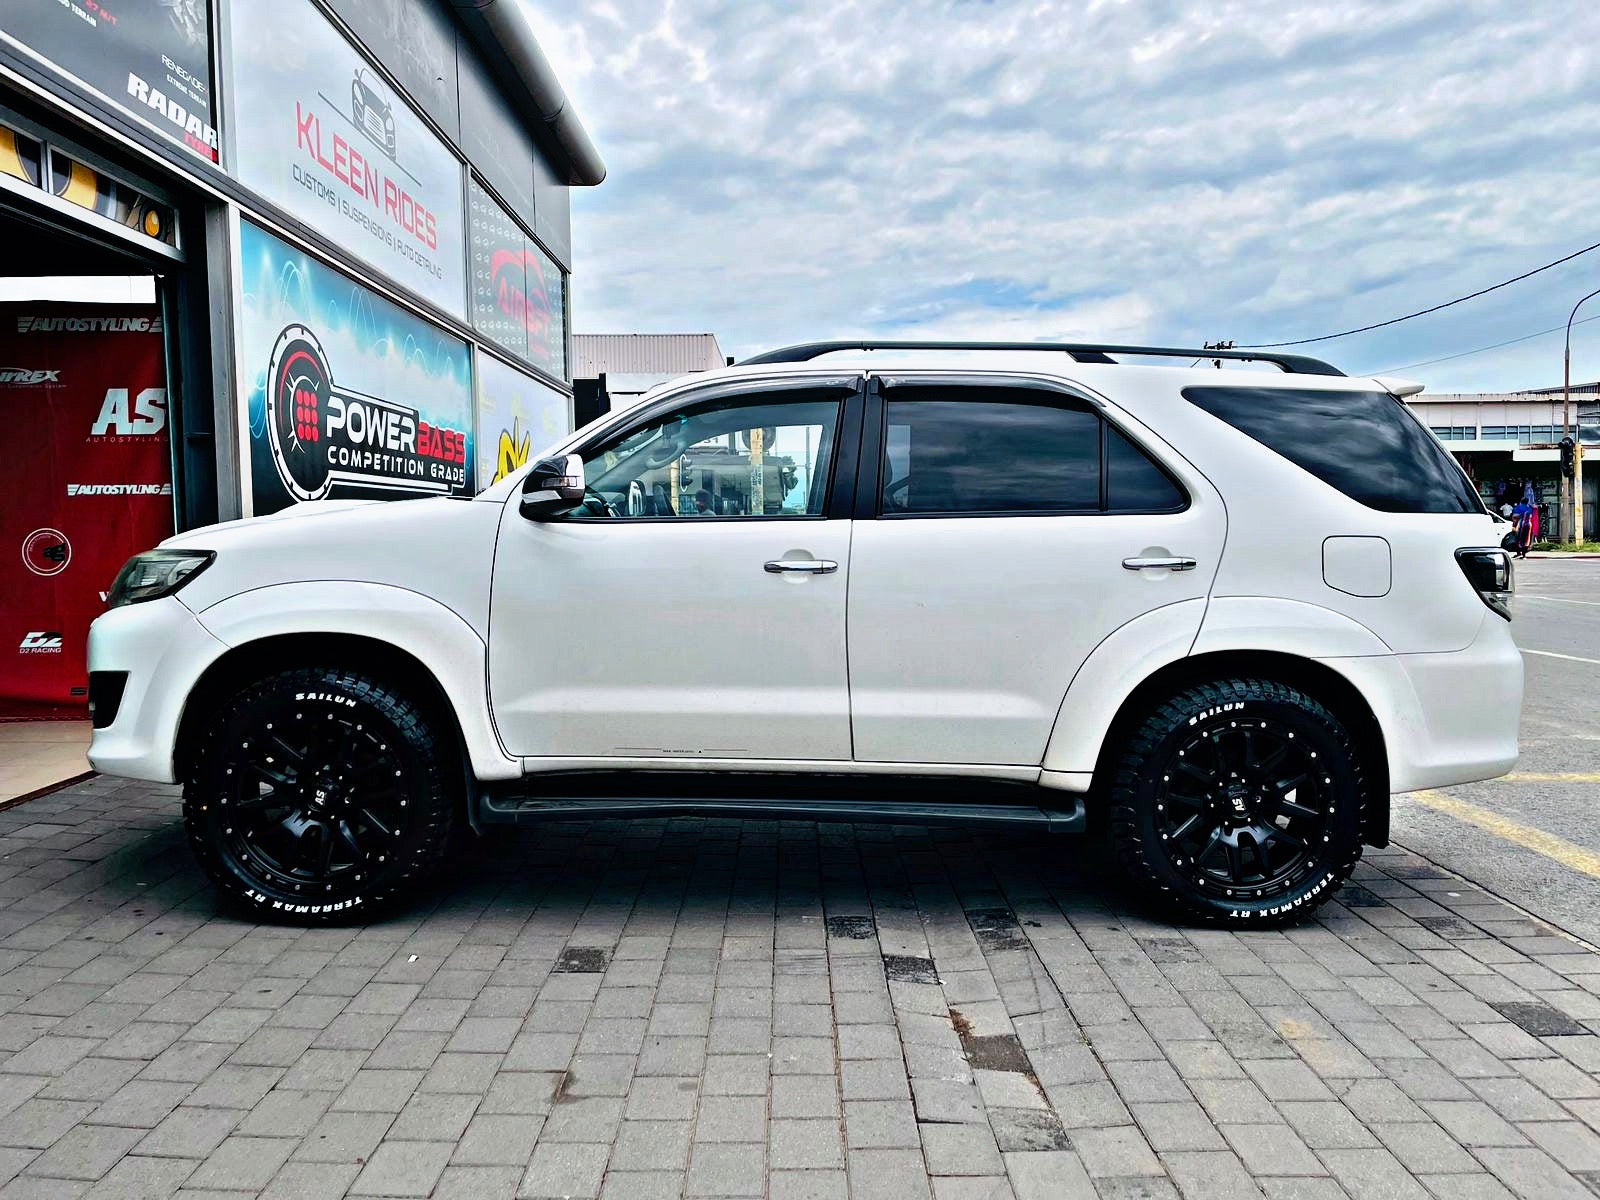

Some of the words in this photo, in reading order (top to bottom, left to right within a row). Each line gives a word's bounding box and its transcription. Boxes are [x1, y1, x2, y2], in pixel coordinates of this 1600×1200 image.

[161, 54, 205, 93] RENEGADE
[127, 72, 218, 151] RADAR
[292, 163, 336, 206] CUSTOMS
[296, 100, 381, 210] KLEEN
[384, 176, 438, 250] RIDES
[30, 317, 150, 332] AUTOSTYLING
[91, 388, 166, 435] AS
[327, 446, 424, 476] COMPETITION
[430, 463, 465, 482] GRADE
[76, 484, 161, 495] AUTOSTYLING
[295, 692, 357, 708] SAILUN
[1188, 702, 1245, 726] SAILUN
[272, 896, 363, 914] TERRAMAX
[1259, 872, 1335, 918] TERRAMAX
